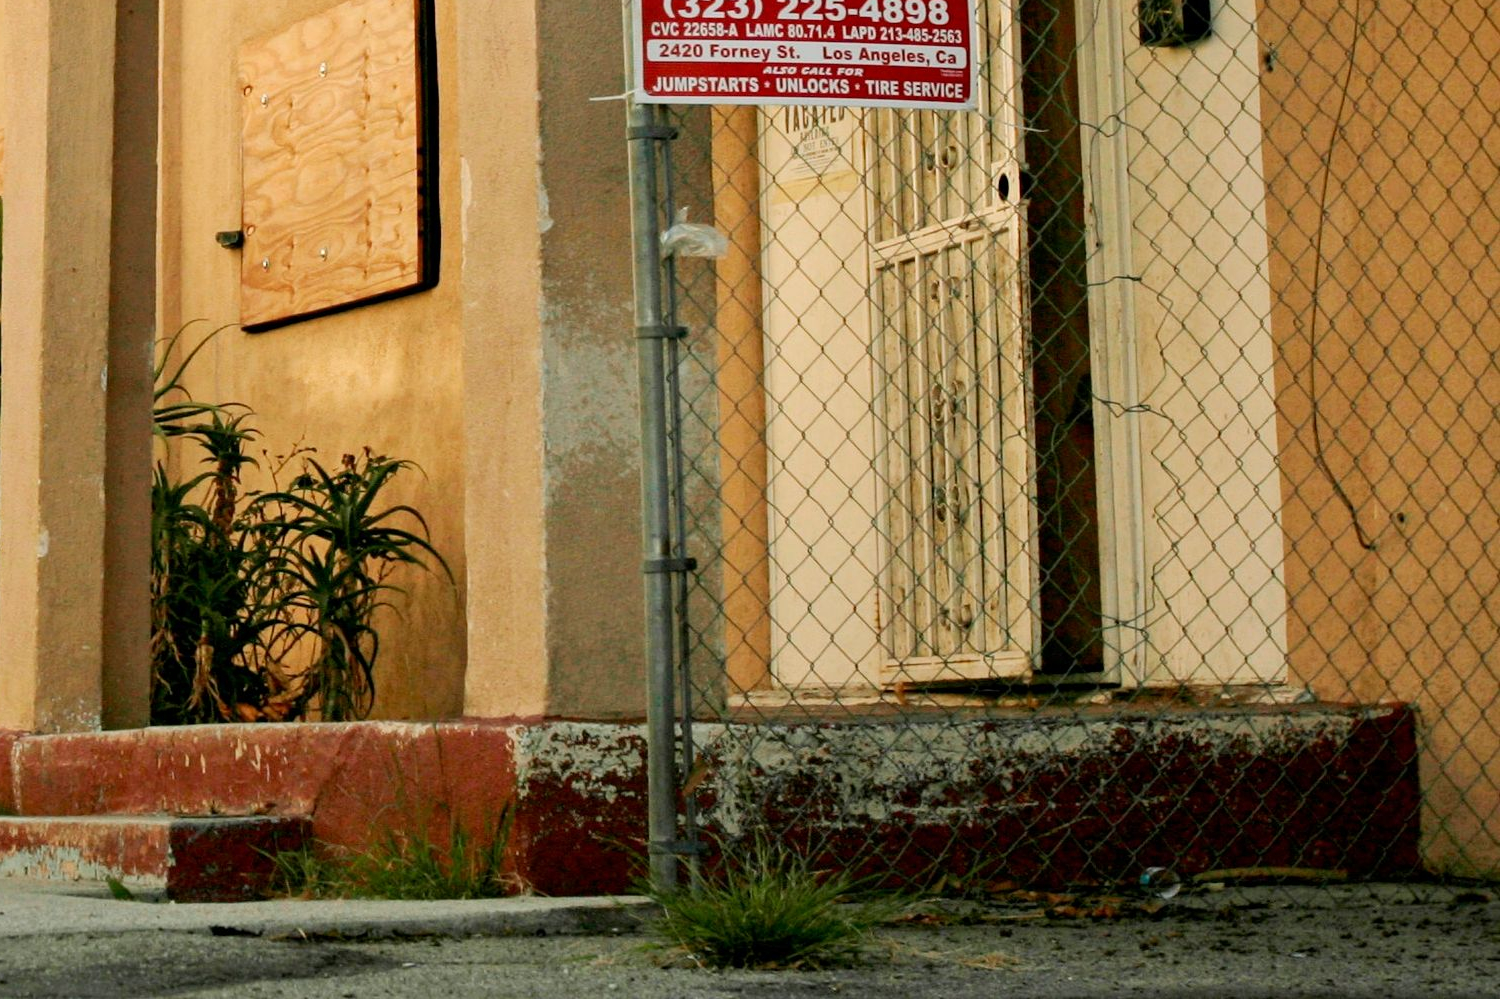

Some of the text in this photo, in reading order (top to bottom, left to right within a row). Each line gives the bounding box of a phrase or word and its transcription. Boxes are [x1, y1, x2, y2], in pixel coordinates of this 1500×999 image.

[651, 22, 962, 43] CVC 22658-A LAMC 80.71.4 LAPD 213-485-2563
[659, 44, 956, 66] 2420 Forney St. Los Angeles, Ca
[763, 66, 864, 76] ALSO CALL FOR
[653, 77, 963, 98] JUMPSTARTS UNLOCKS TIRE SERVICE
